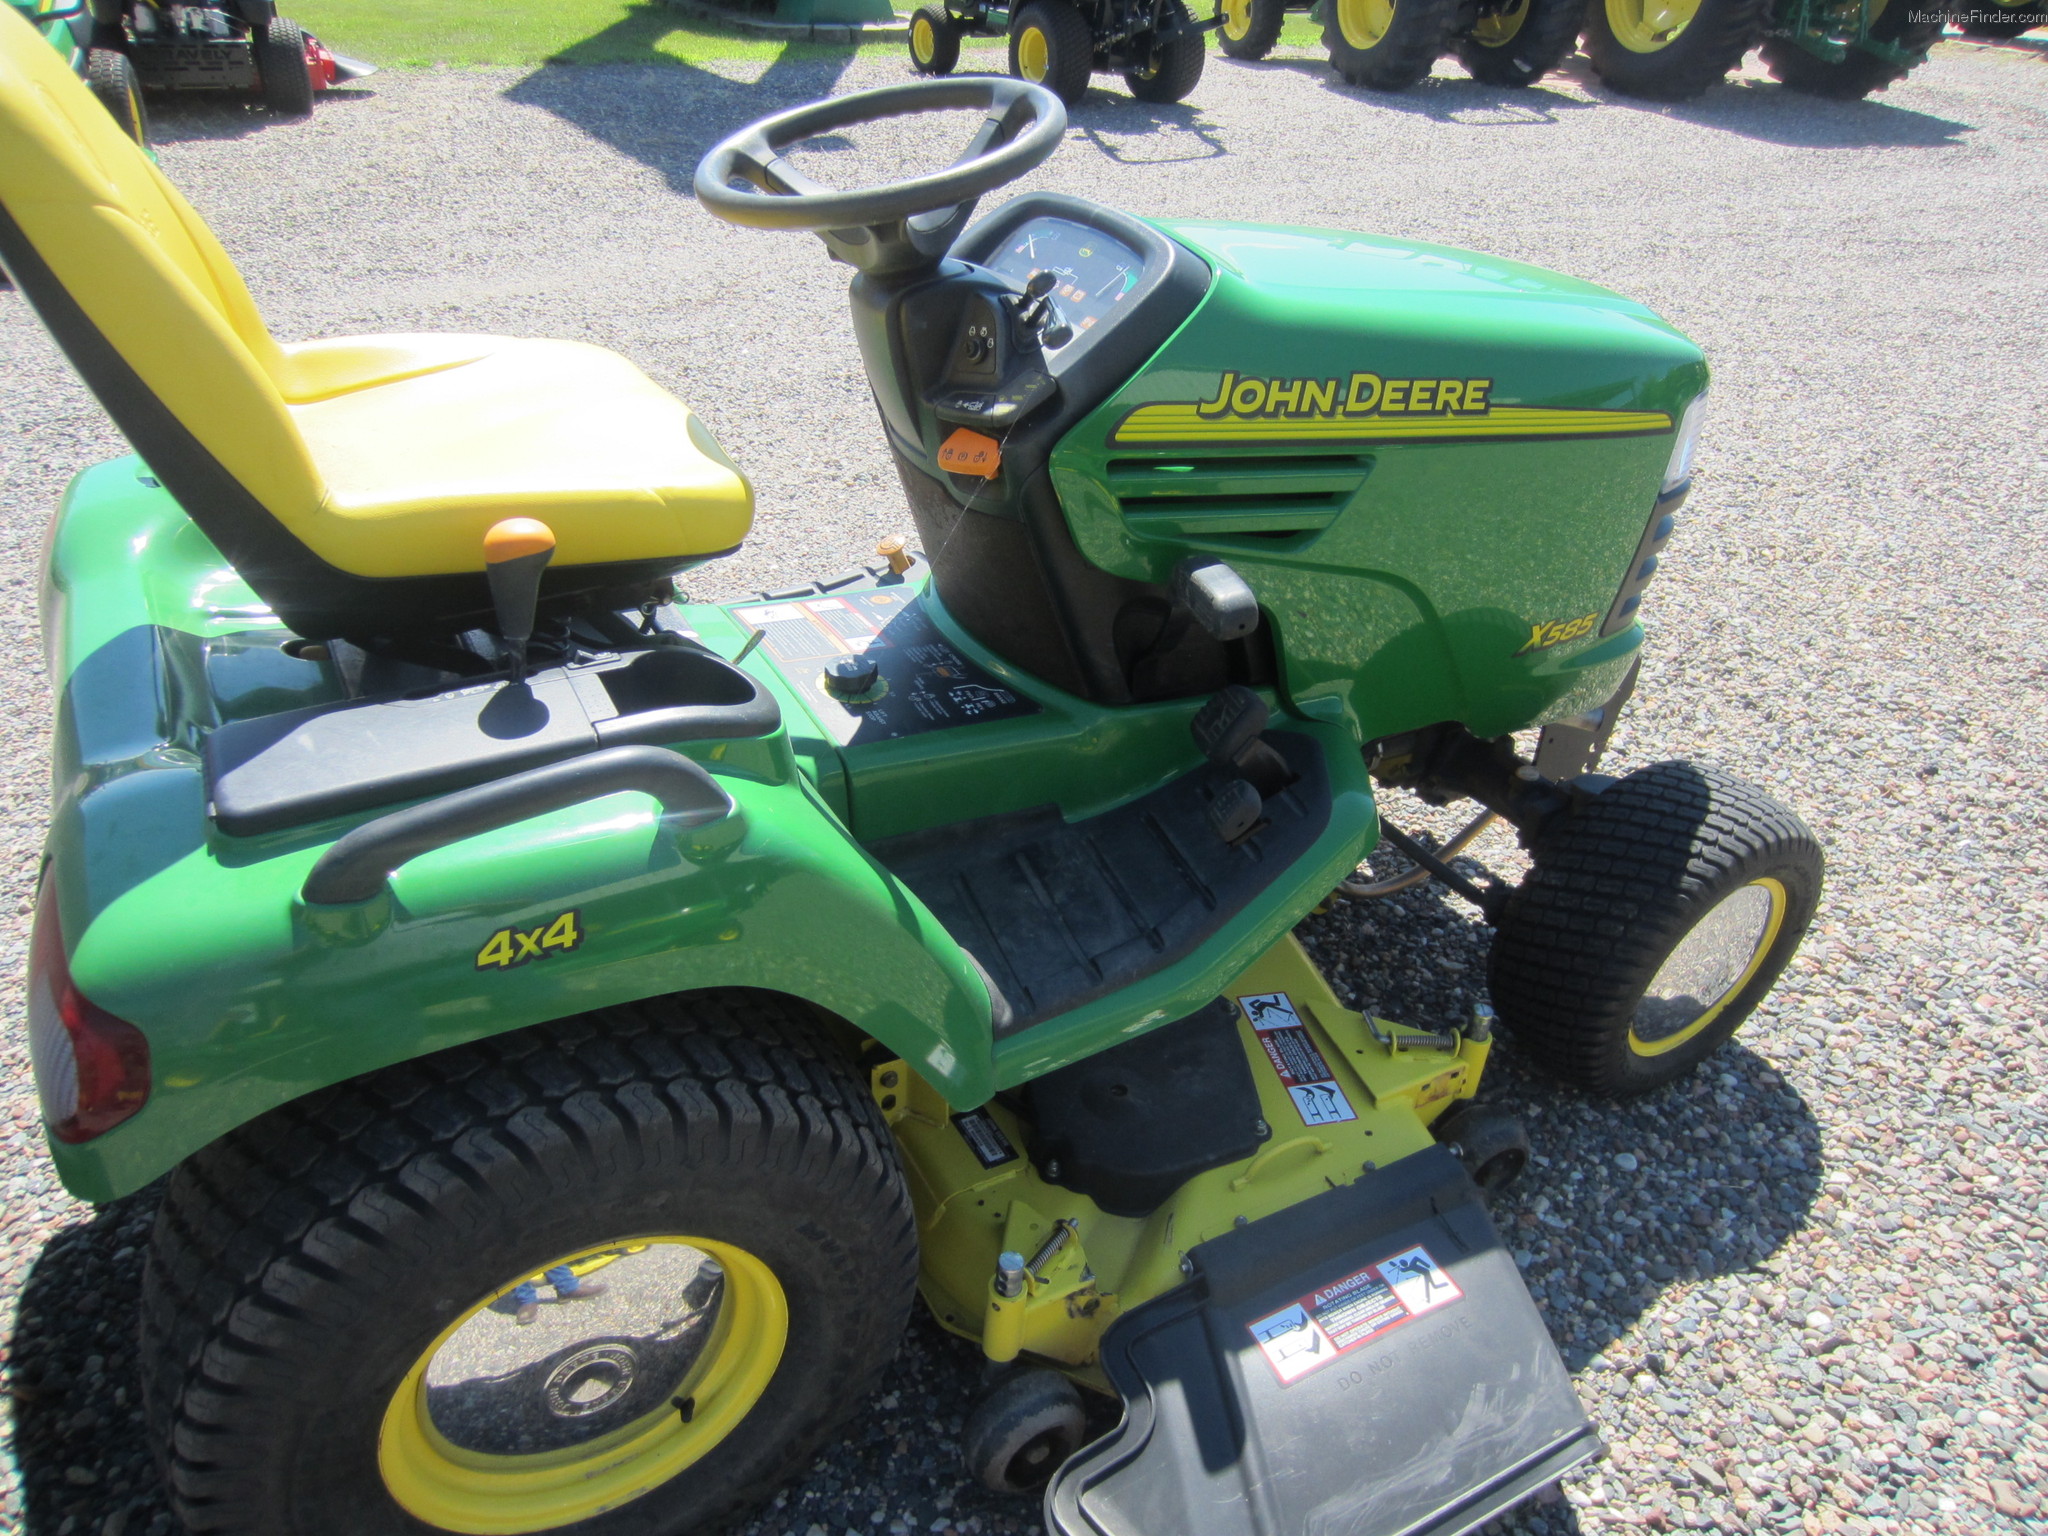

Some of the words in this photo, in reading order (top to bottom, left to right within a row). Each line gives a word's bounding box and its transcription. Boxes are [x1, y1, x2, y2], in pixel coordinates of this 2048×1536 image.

[1198, 371, 1339, 416] JOHN
[1343, 371, 1492, 415] DEERE
[1514, 612, 1599, 654] X585
[476, 910, 580, 968] 4x4
[1262, 1037, 1285, 1070] DANGER
[1324, 1272, 1371, 1299] DANGER
[1337, 1371, 1363, 1391] DO
[1368, 1348, 1400, 1375] NOT
[1408, 1317, 1472, 1355] REMOVE
